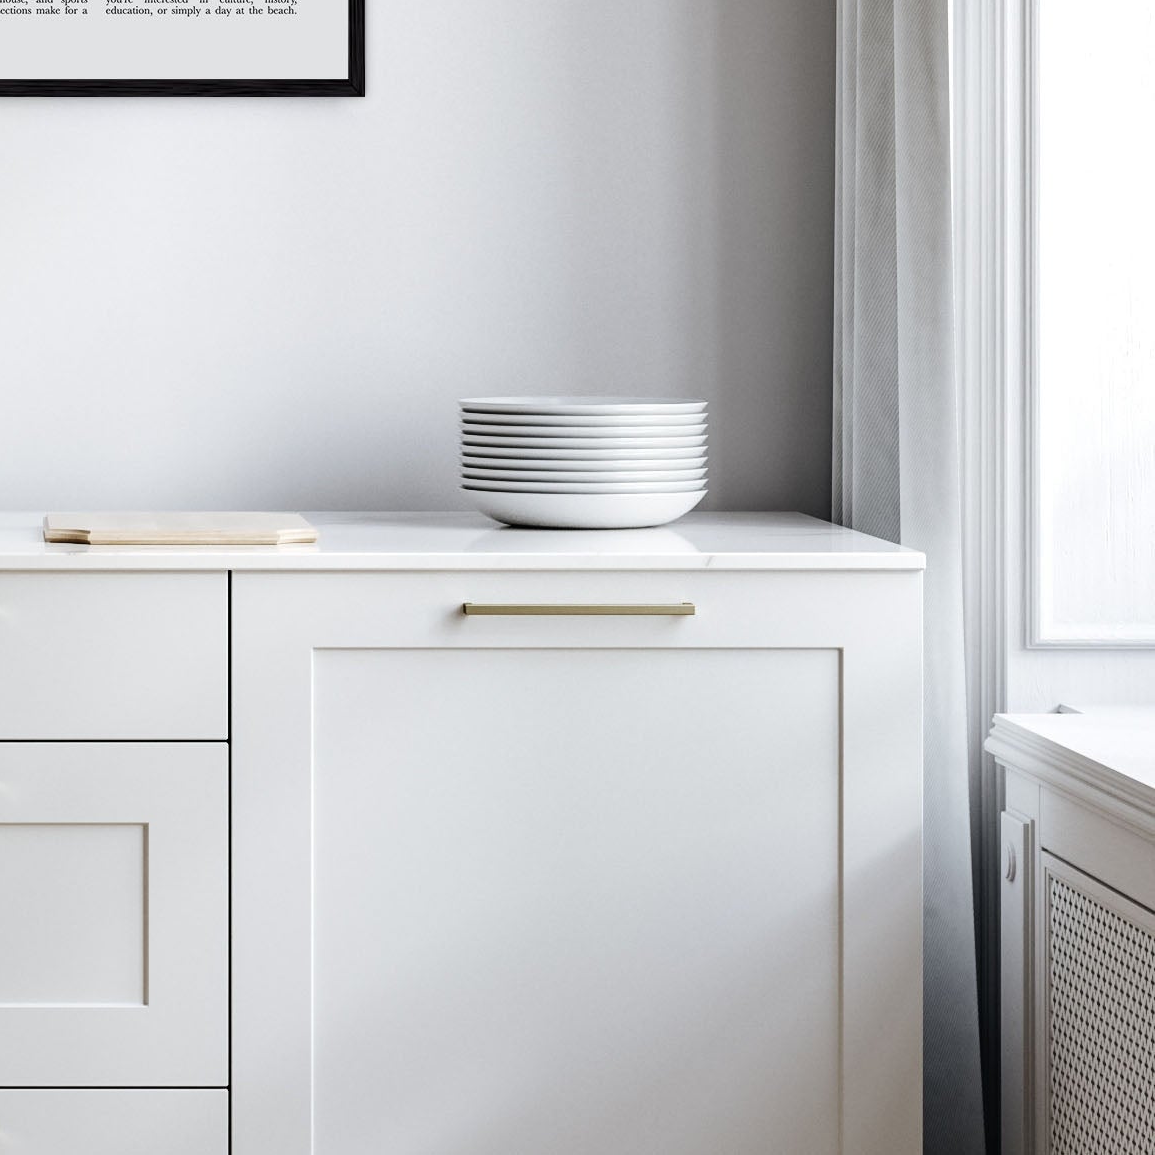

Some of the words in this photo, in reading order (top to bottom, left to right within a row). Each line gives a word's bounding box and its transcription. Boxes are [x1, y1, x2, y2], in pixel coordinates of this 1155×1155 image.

[36, 6, 61, 15] make
[64, 6, 79, 15] for
[105, 6, 153, 16] education,
[171, 6, 202, 17] simply
[214, 6, 232, 17] day
[235, 6, 245, 15] at
[248, 6, 264, 15] the
[267, 6, 297, 15] beach.
